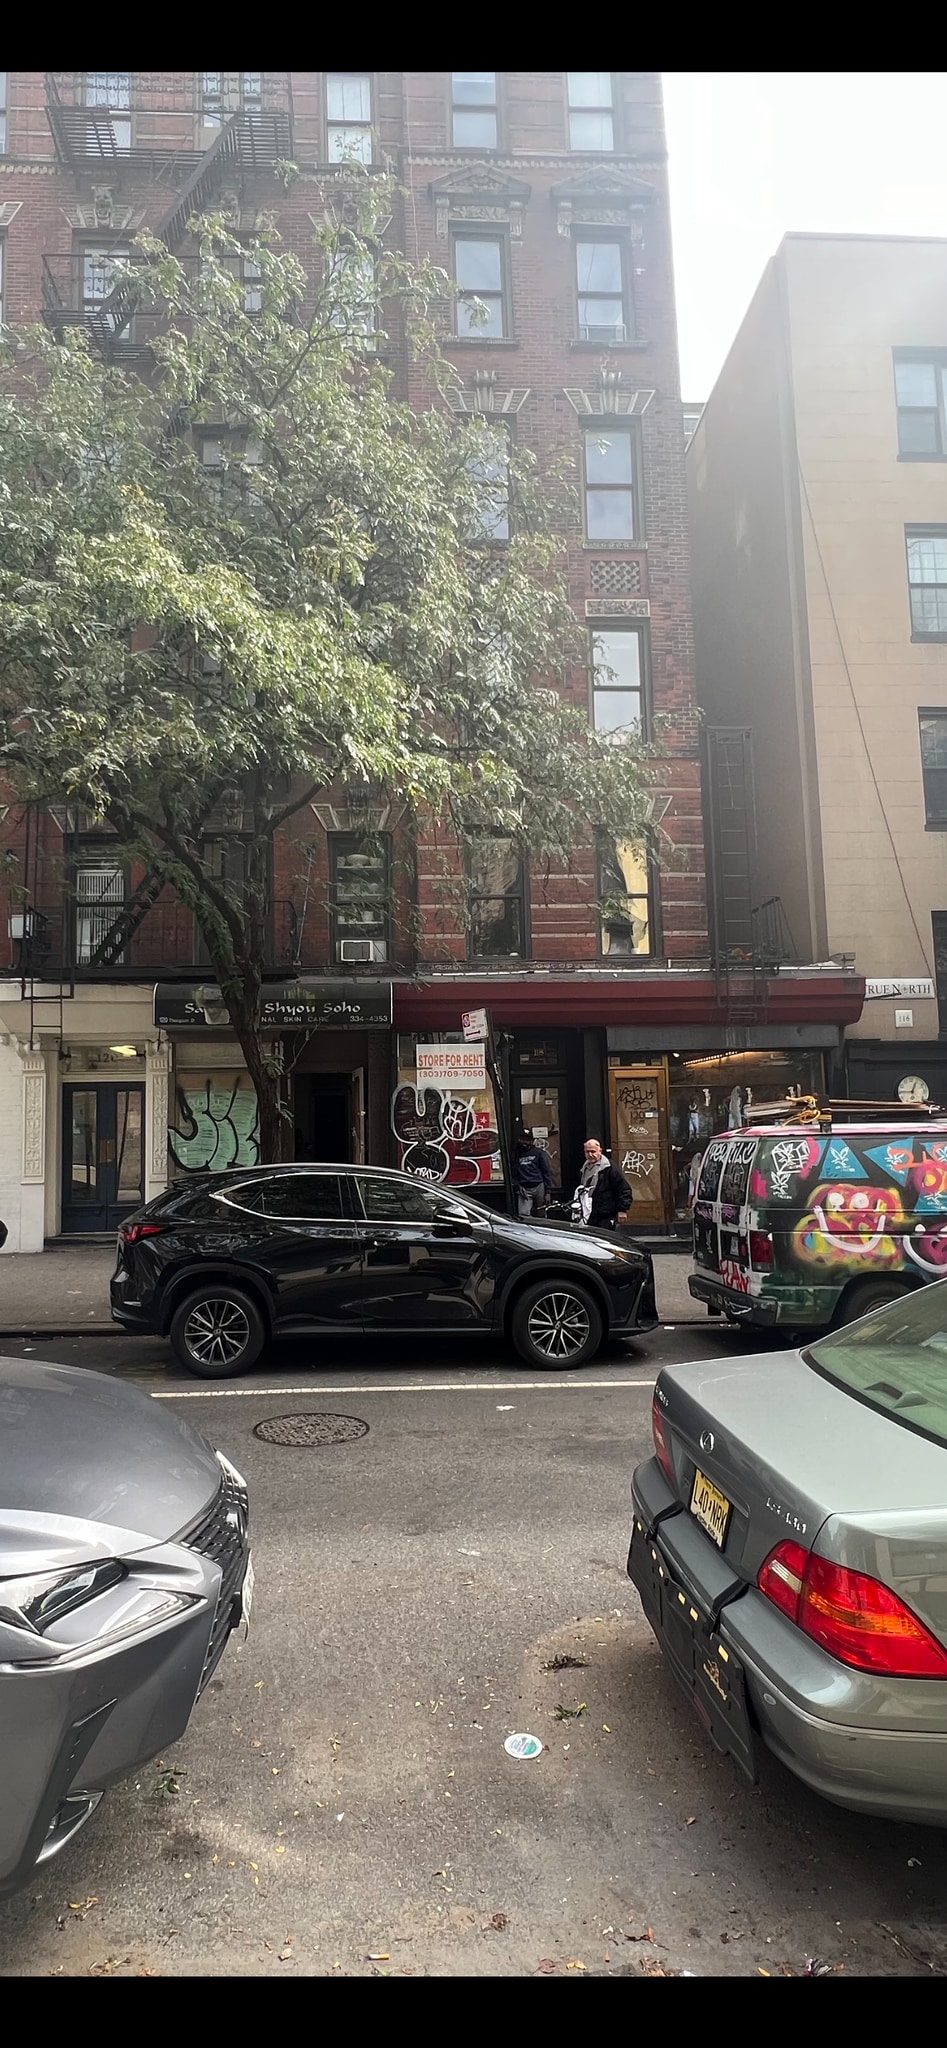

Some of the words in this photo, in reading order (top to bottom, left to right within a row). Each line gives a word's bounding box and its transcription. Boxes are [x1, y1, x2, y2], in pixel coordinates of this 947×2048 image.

[865, 984, 891, 995] RUE
[264, 1001, 316, 1016] Shyou
[322, 1001, 361, 1014] Soho
[418, 1054, 444, 1067] STORE
[445, 1054, 462, 1067] FOR
[463, 1054, 484, 1067] RENT
[419, 1069, 484, 1078] (303)709-7050
